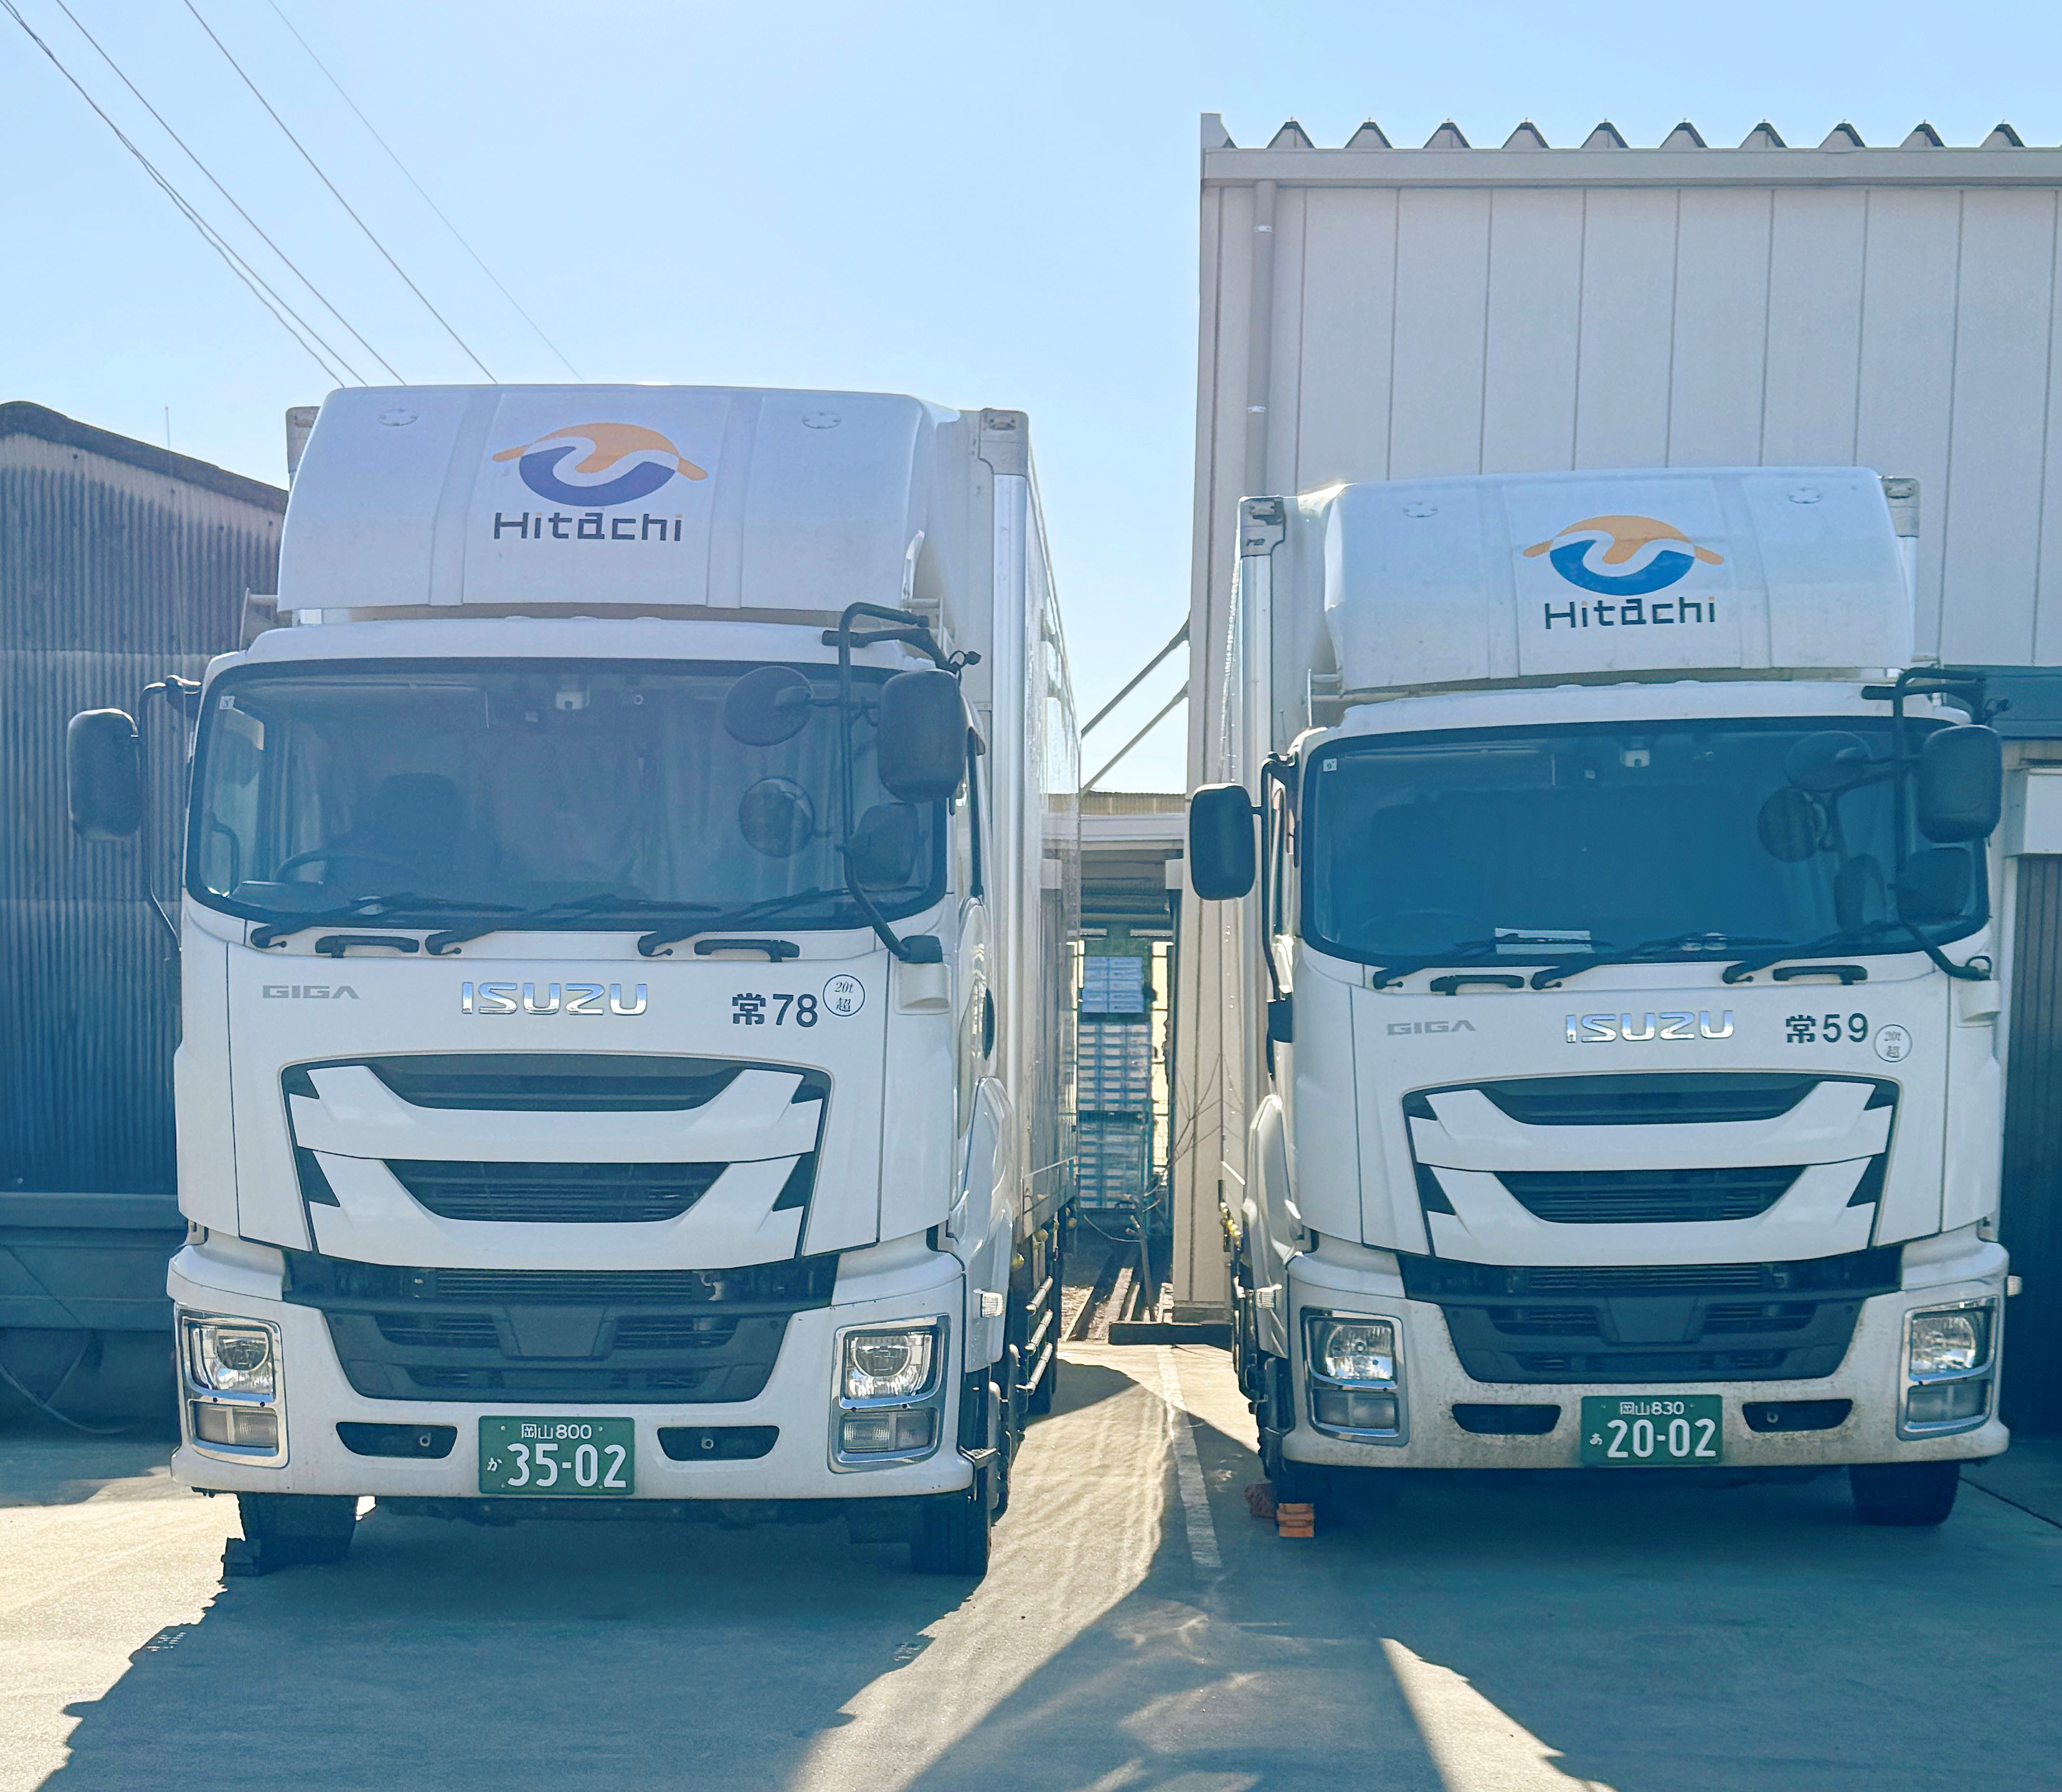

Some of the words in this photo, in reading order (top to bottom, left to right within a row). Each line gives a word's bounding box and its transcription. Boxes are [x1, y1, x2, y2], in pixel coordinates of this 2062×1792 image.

[493, 512, 683, 541] Hitachi
[1545, 596, 1715, 629] Hitachi
[262, 985, 360, 999] GIGA
[462, 982, 647, 1015] ISUZU
[834, 982, 854, 993] 20t
[732, 993, 818, 1027] 常78
[836, 998, 851, 1011] 超
[1387, 1020, 1477, 1036] GIGA
[1565, 1010, 1734, 1043] ISUZU
[1607, 1418, 1716, 1458] 20-02
[487, 1457, 502, 1472] か
[507, 1443, 626, 1488] 35-02
